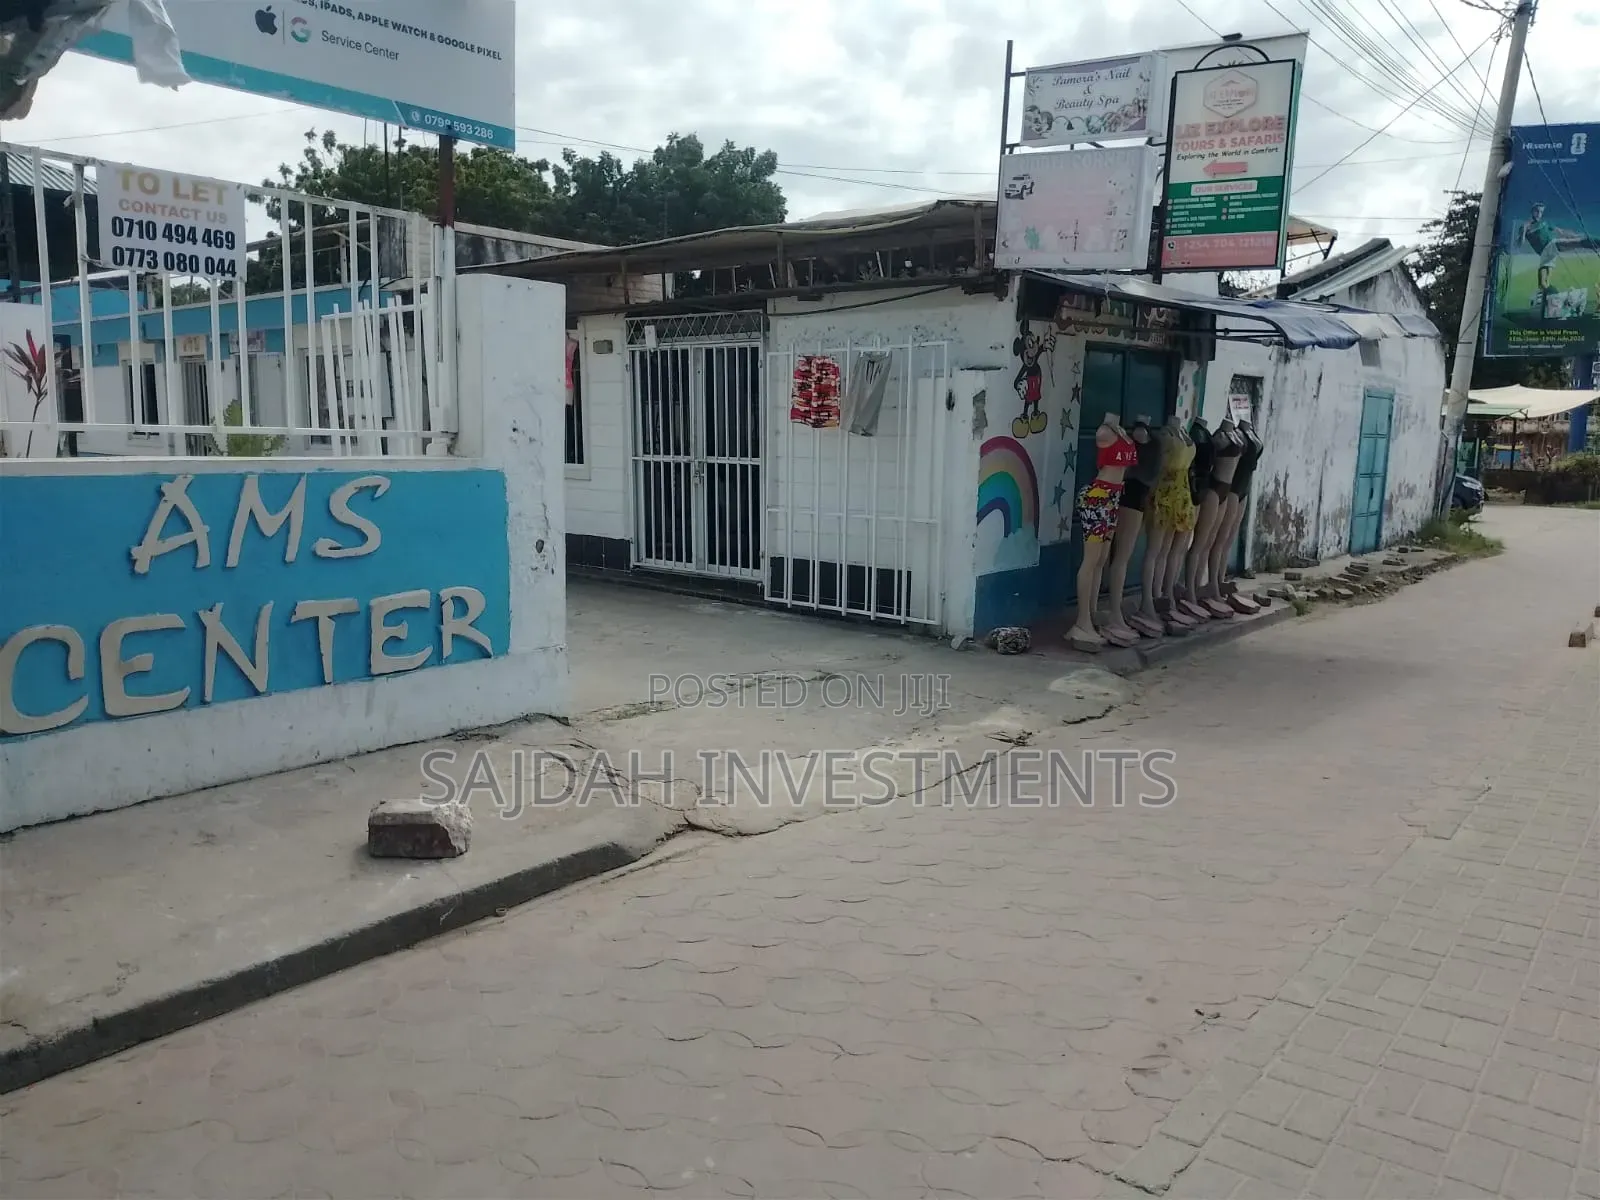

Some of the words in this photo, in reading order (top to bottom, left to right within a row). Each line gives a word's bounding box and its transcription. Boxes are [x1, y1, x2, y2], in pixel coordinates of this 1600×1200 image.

[321, 30, 362, 51] Service
[364, 42, 400, 61] Center
[357, 12, 389, 28] APPLE
[391, 21, 427, 39] WATCH
[430, 33, 435, 41] &
[437, 35, 475, 53] GOOGLE
[477, 46, 502, 61] PIXEL
[1105, 66, 1131, 81] Nail
[1054, 98, 1094, 110] Beauty
[1097, 95, 1120, 108] Spa
[453, 121, 473, 135] 593
[1175, 139, 1216, 152] TOURS
[1230, 133, 1285, 148] SAFARIS
[1176, 152, 1206, 161] Exploring
[1221, 148, 1241, 157] World
[1251, 146, 1280, 155] Comfort
[116, 170, 161, 195] TO
[172, 176, 228, 205] LET
[118, 199, 202, 219] CONTACT
[206, 211, 228, 224] US
[111, 216, 157, 241] 0710
[162, 223, 198, 245] 494
[202, 228, 236, 250] 469
[112, 246, 159, 270] 0773
[163, 252, 200, 274] 080
[204, 256, 237, 277] 044
[130, 474, 391, 575] AMS
[0, 586, 494, 736] CENTER
